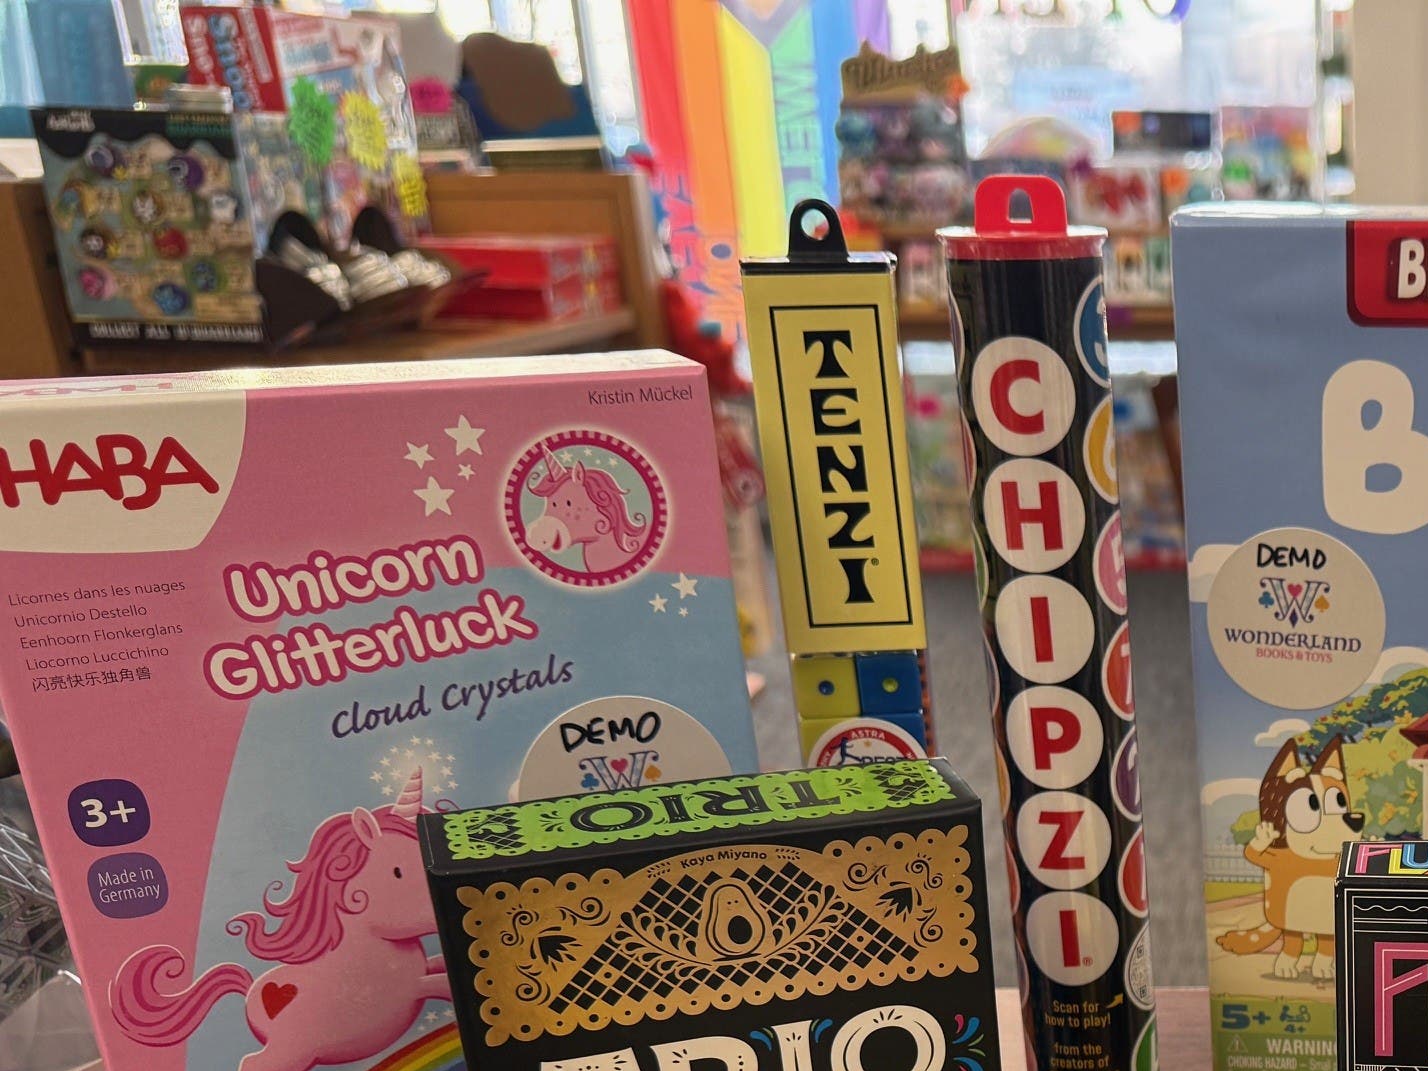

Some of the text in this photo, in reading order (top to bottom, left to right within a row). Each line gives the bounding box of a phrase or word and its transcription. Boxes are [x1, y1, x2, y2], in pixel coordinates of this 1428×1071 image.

[588, 385, 693, 406] Kristin Mückel
[0, 434, 219, 511] HABA
[803, 330, 875, 604] TENZI
[1256, 543, 1327, 570] DEMO
[226, 537, 482, 620] Unicorn
[8, 580, 186, 607] Licornes dans les nuages
[15, 604, 147, 628] Unicornio Destello
[20, 623, 183, 649] Eenhoorn Flonkerglans
[206, 590, 537, 697] Glitterluck
[1224, 628, 1362, 653] WONDERLAND
[27, 646, 169, 671] Liocorno Luccichino
[1256, 648, 1333, 664] BOOKS TOYS
[32, 668, 152, 692] 闪亮快乐独角兽
[332, 655, 574, 738] Cloud Crystals
[560, 711, 660, 753] DEMO
[851, 729, 886, 740] ASTRA
[81, 799, 136, 829] 3+
[569, 780, 843, 832] TRIO
[681, 847, 767, 869] Kaya Miyano
[98, 865, 155, 887] Made in
[99, 882, 161, 906] Germany
[1053, 1000, 1099, 1014] Scan for
[1221, 1003, 1271, 1030] 5+
[1045, 1012, 1111, 1030] how to play!
[1054, 1042, 1102, 1055] from the
[1050, 1055, 1109, 1069] creators of
[1228, 1056, 1297, 1070] CHOKING HAZARD
